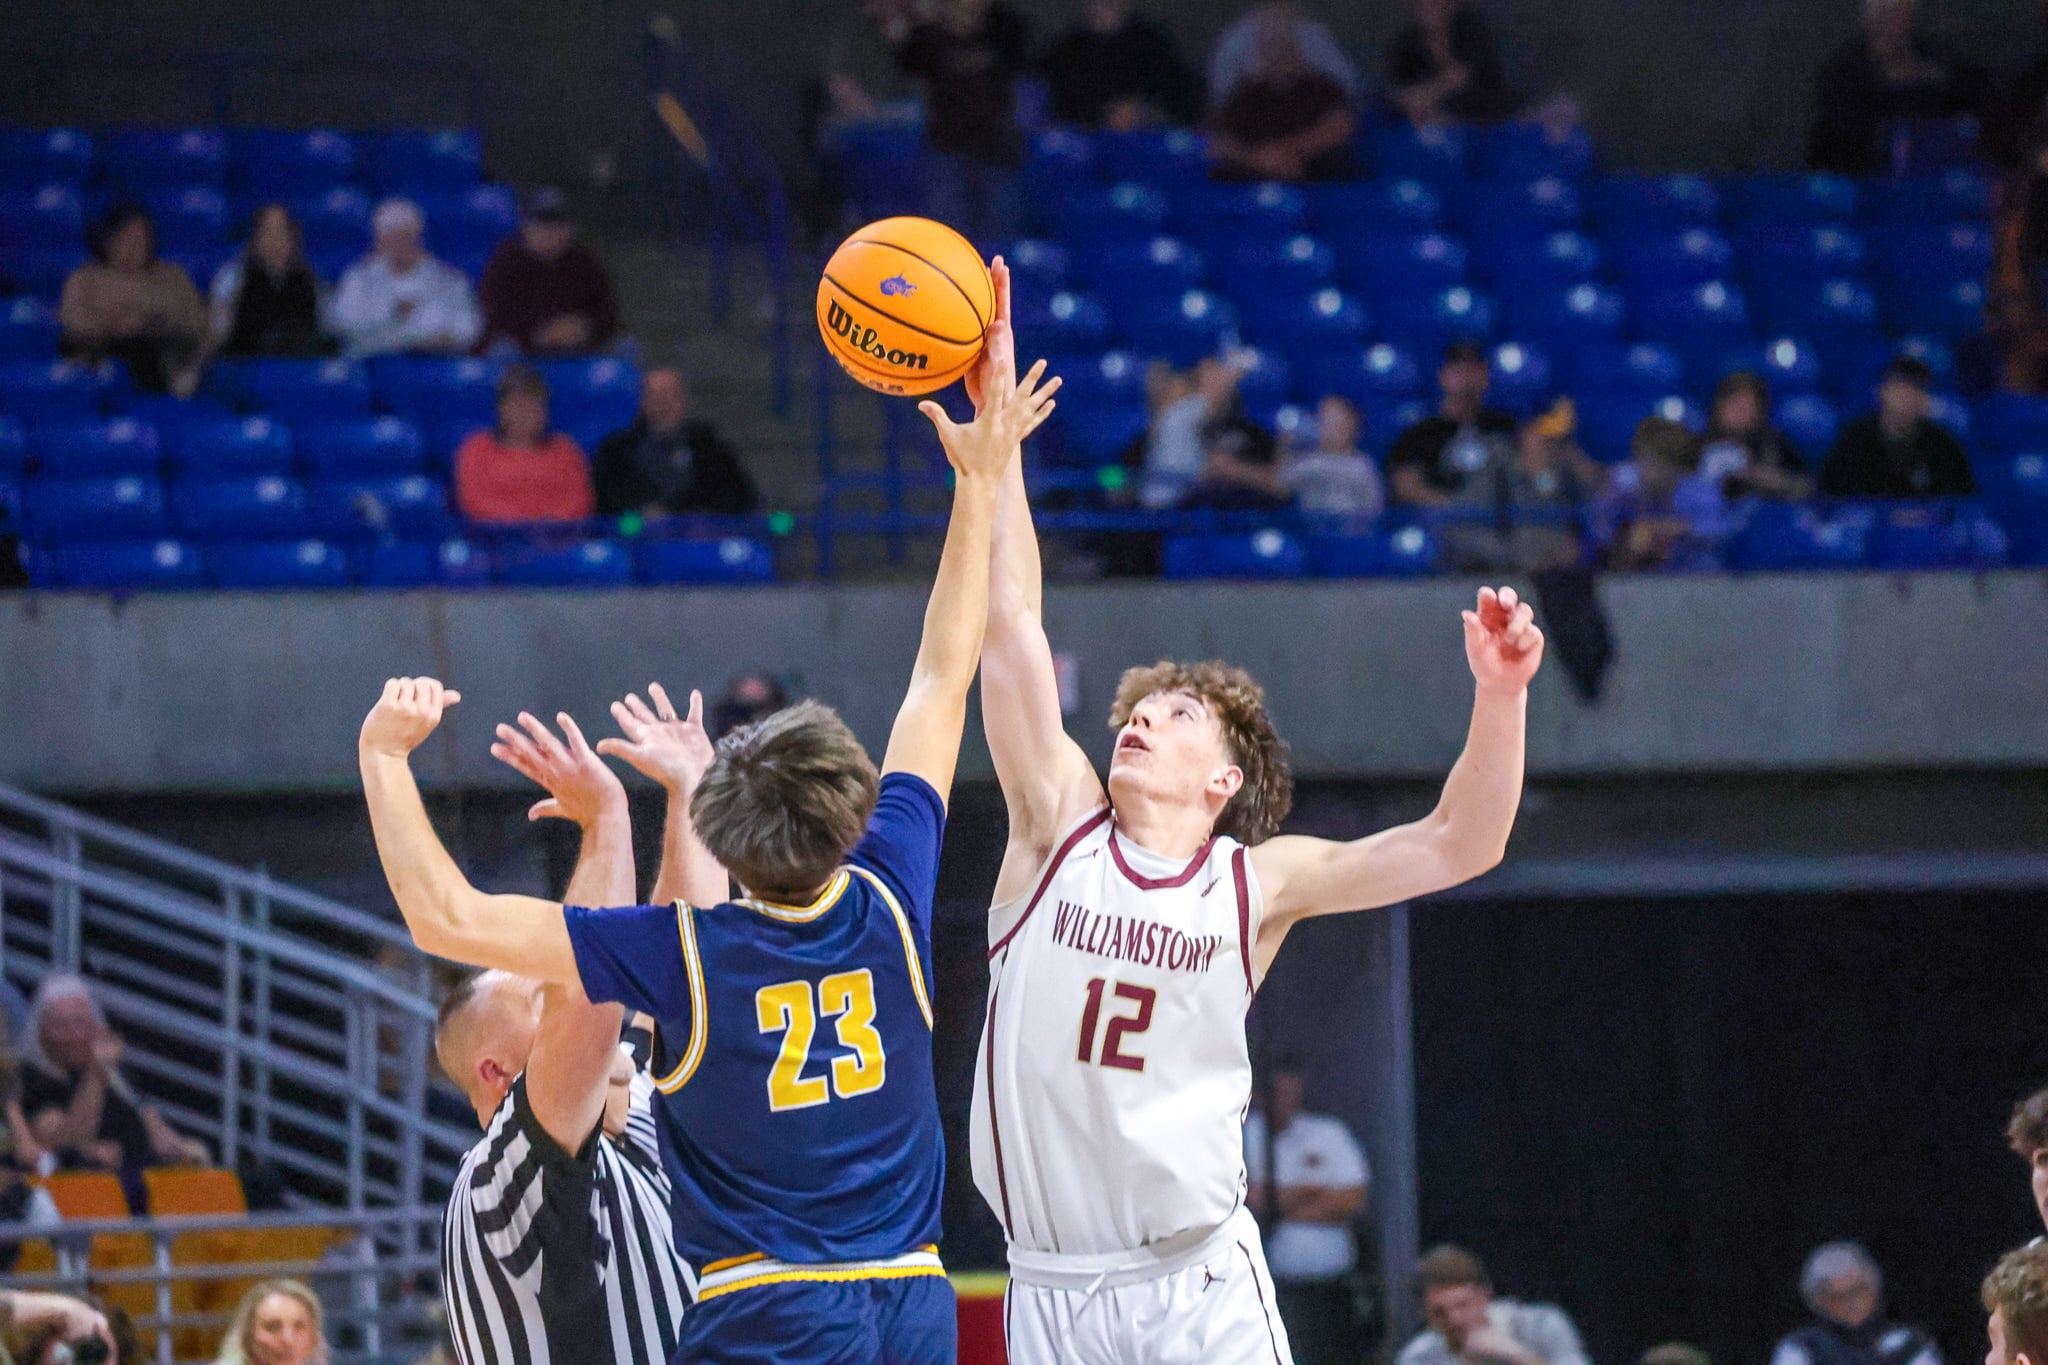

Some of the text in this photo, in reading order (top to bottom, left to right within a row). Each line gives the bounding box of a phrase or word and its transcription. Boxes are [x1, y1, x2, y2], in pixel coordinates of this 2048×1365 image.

[827, 297, 929, 370] Wilson
[755, 967, 886, 1112] 23
[1076, 976, 1158, 1073] 12
